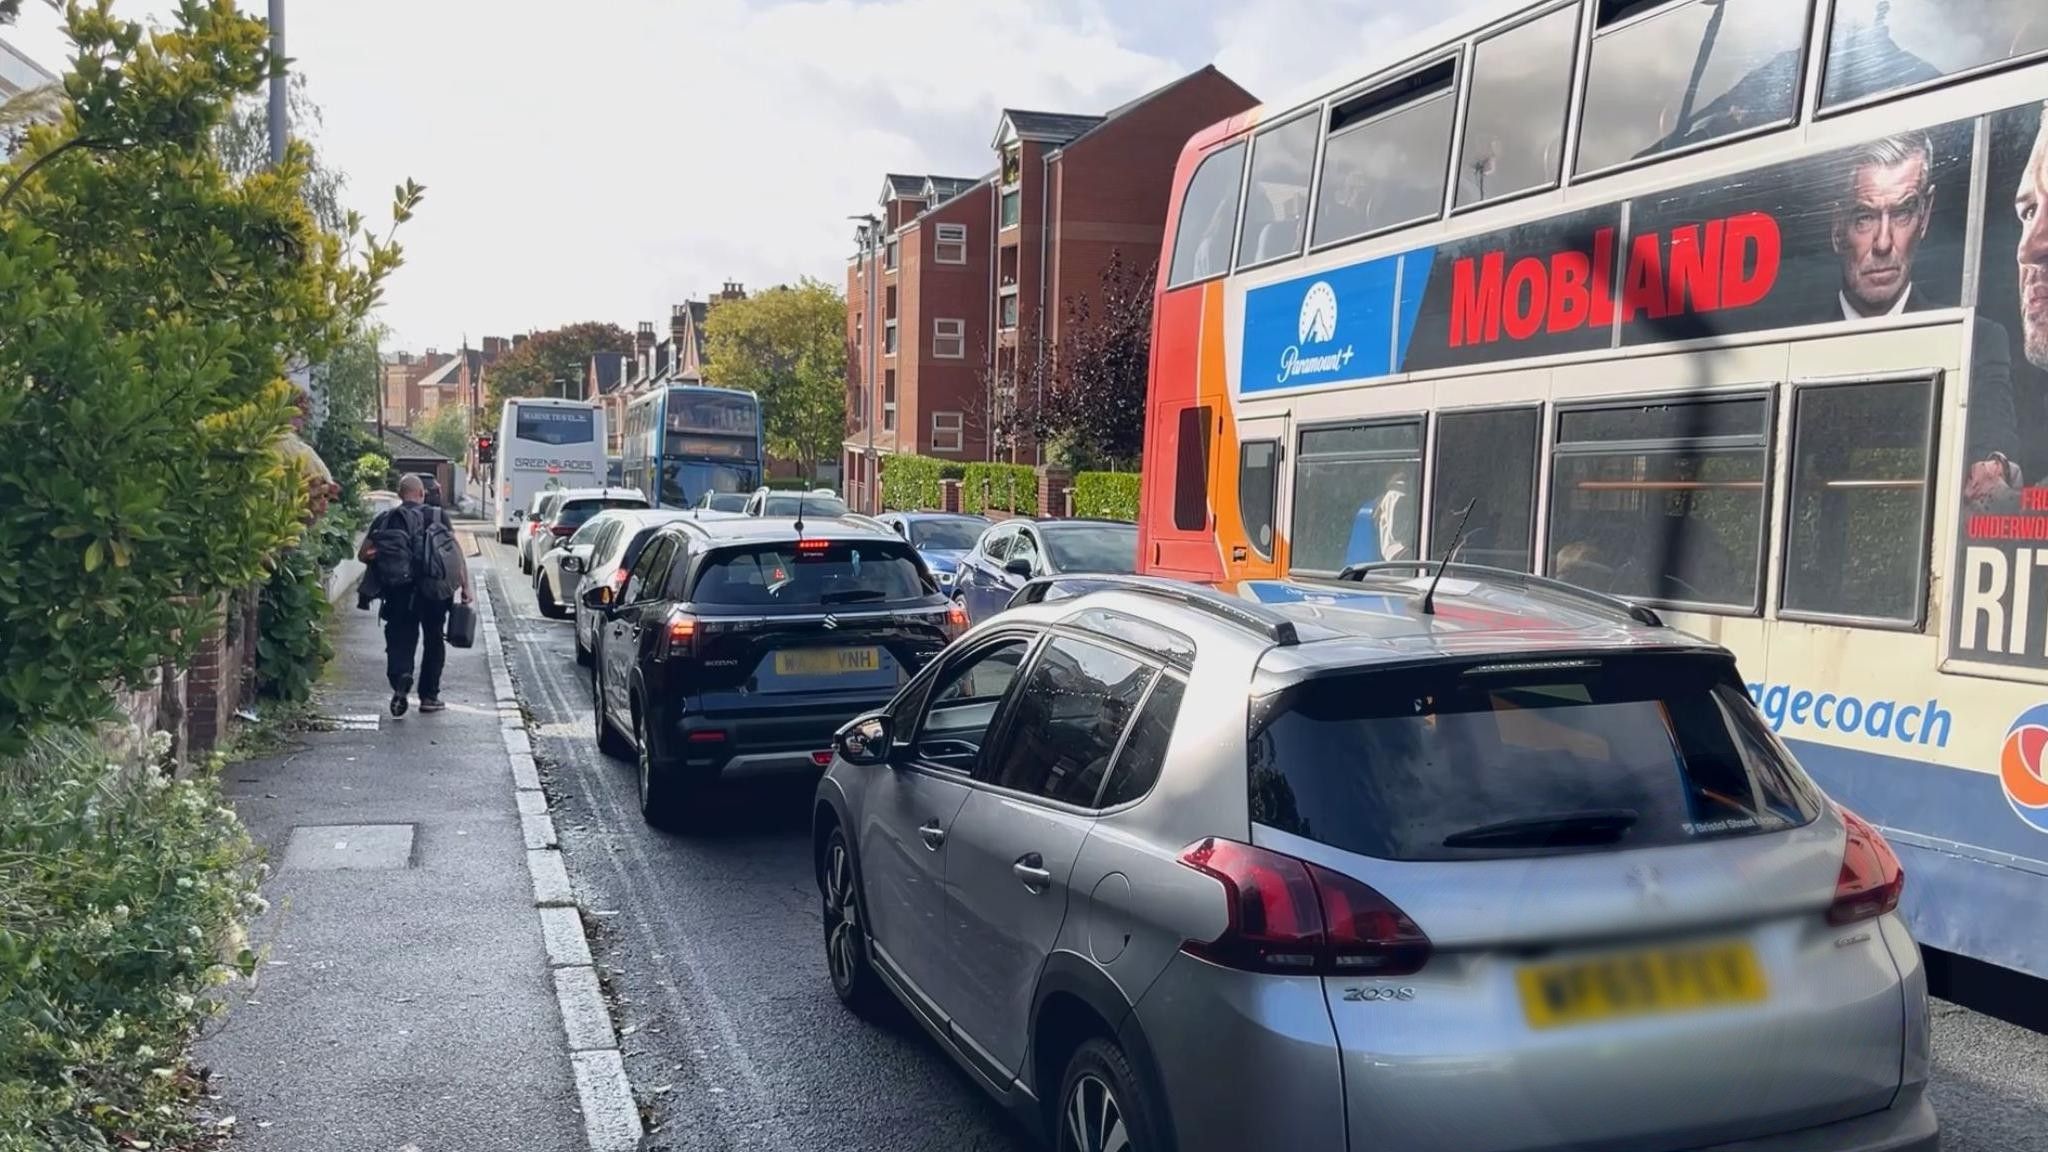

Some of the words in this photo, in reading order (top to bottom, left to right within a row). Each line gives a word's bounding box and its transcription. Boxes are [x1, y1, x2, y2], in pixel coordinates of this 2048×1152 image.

[1448, 211, 1782, 348] MOBLAND
[1276, 344, 1355, 384] Paramount+
[514, 457, 594, 470] GREENSLADES
[1695, 820, 1728, 833] Bristol
[1727, 818, 1756, 830] Street
[1343, 986, 1416, 1002] 2008
